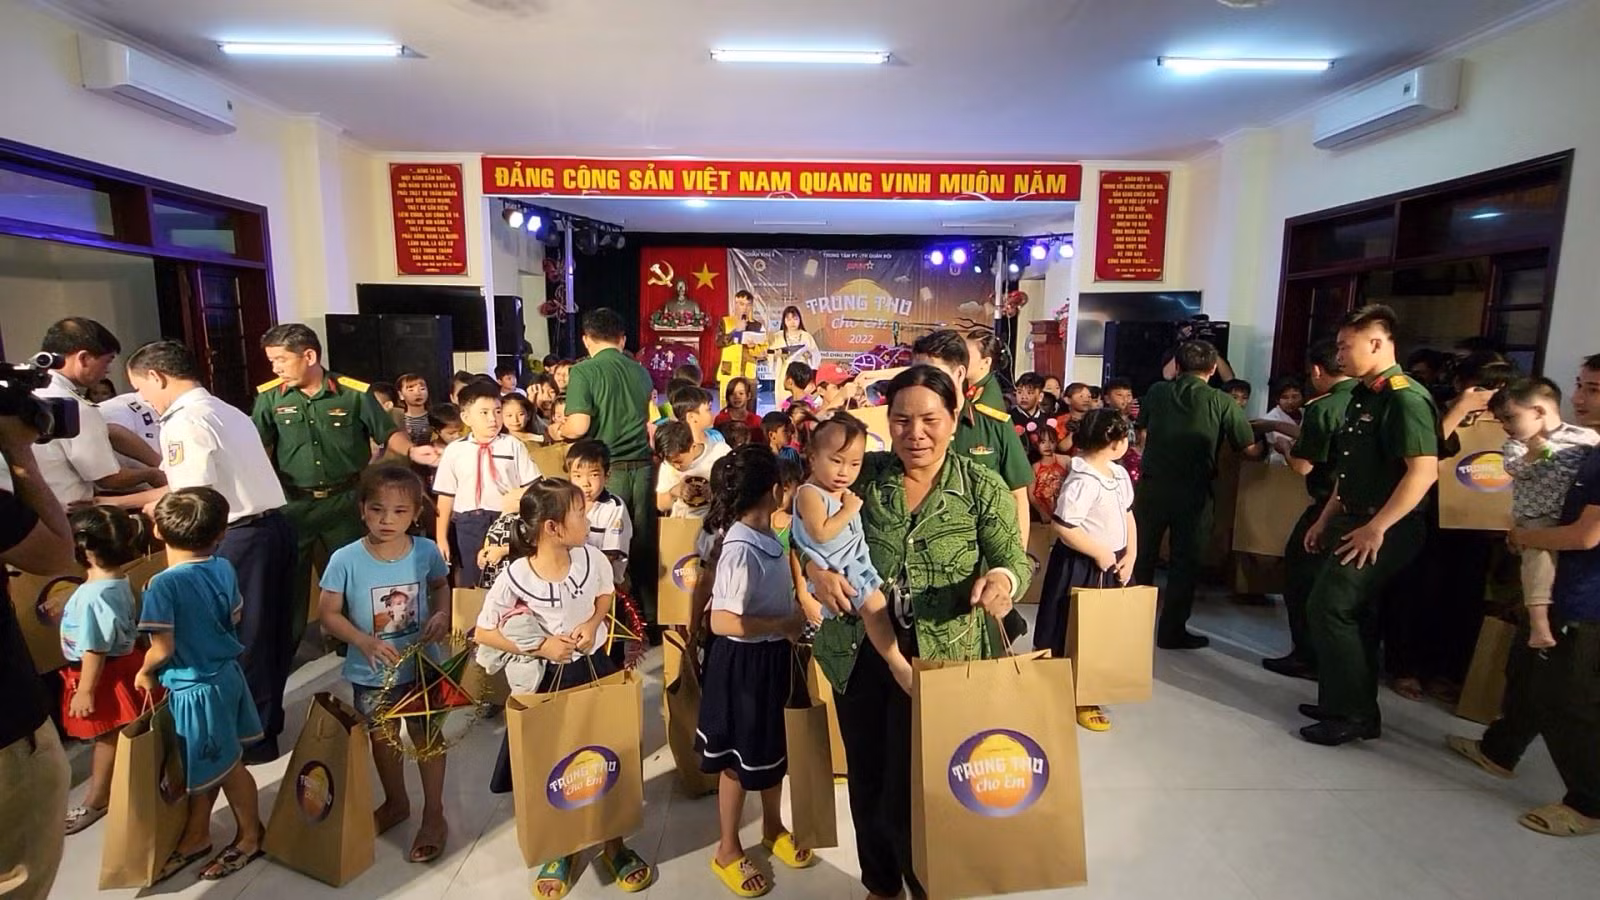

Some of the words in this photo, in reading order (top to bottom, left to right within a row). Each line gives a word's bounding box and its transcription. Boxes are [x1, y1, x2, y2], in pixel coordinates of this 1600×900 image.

[495, 161, 555, 188] ĐẢNG
[563, 165, 621, 193] CỘNG
[629, 163, 674, 190] SẢN
[682, 167, 731, 194] VIỆT
[739, 171, 791, 192] NAM
[799, 171, 873, 195] QUANG
[880, 172, 931, 193] VINH
[939, 170, 1004, 194] MUÔN
[1014, 170, 1067, 194] NĂM
[806, 295, 868, 315] TRUNG
[876, 295, 912, 316] THU
[848, 334, 874, 344] 2022
[549, 766, 588, 793] TRUNG
[951, 755, 1006, 782] TRUNG
[1010, 756, 1044, 775] THU
[976, 777, 1001, 793] cho
